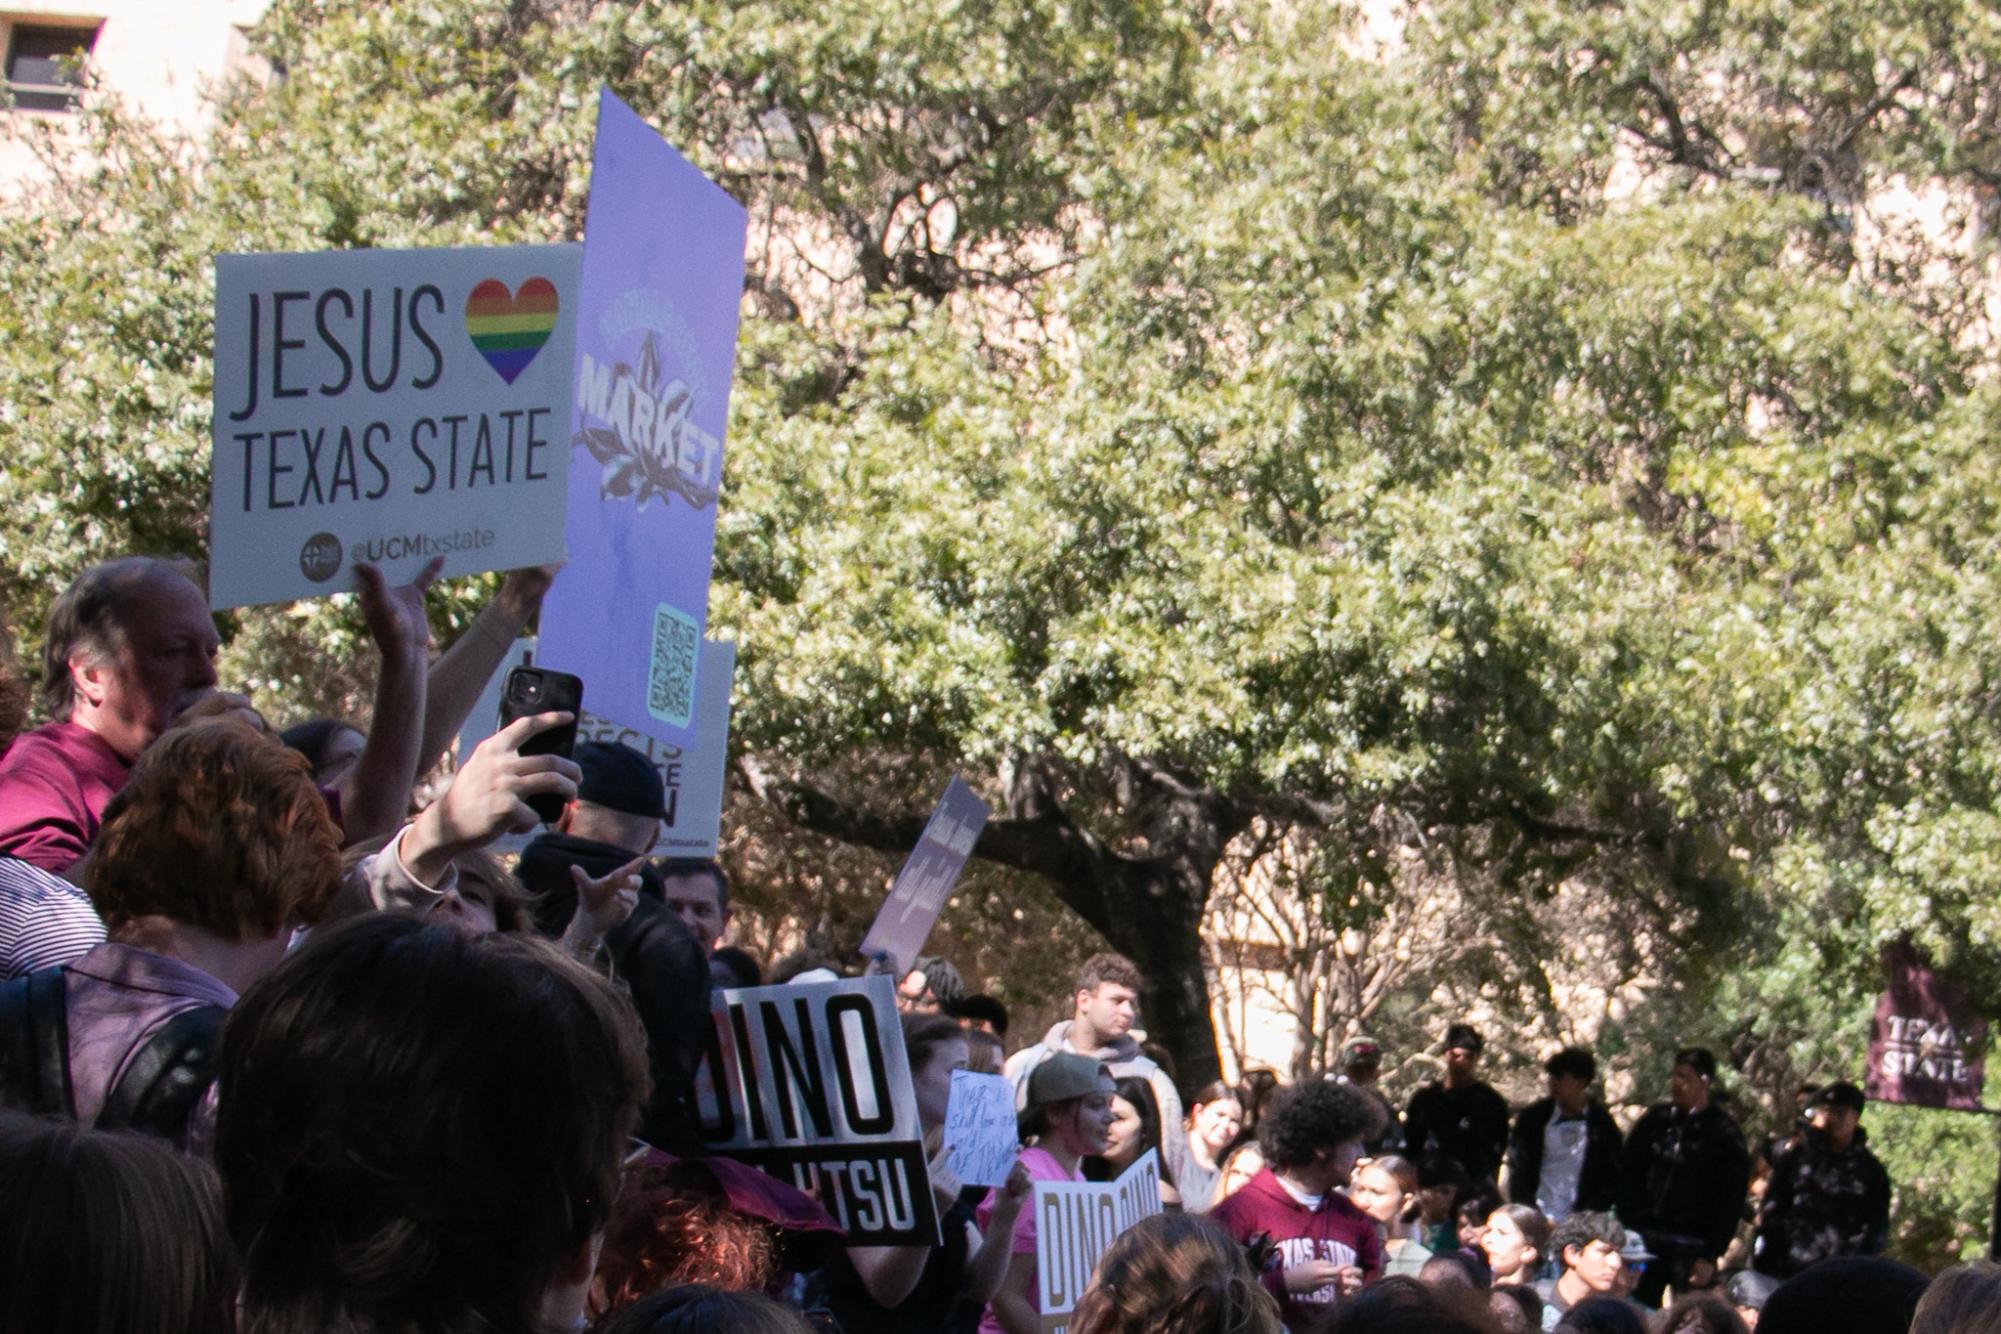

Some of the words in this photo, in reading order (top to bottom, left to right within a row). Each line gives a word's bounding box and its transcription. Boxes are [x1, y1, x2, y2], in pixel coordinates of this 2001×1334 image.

[229, 283, 445, 422] JESUS
[233, 421, 392, 512] TEXAS
[410, 407, 551, 495] STATE
[577, 352, 719, 486] MARKET
[350, 527, 495, 562] @UCMtxstate
[1881, 1050, 1969, 1082] STATE
